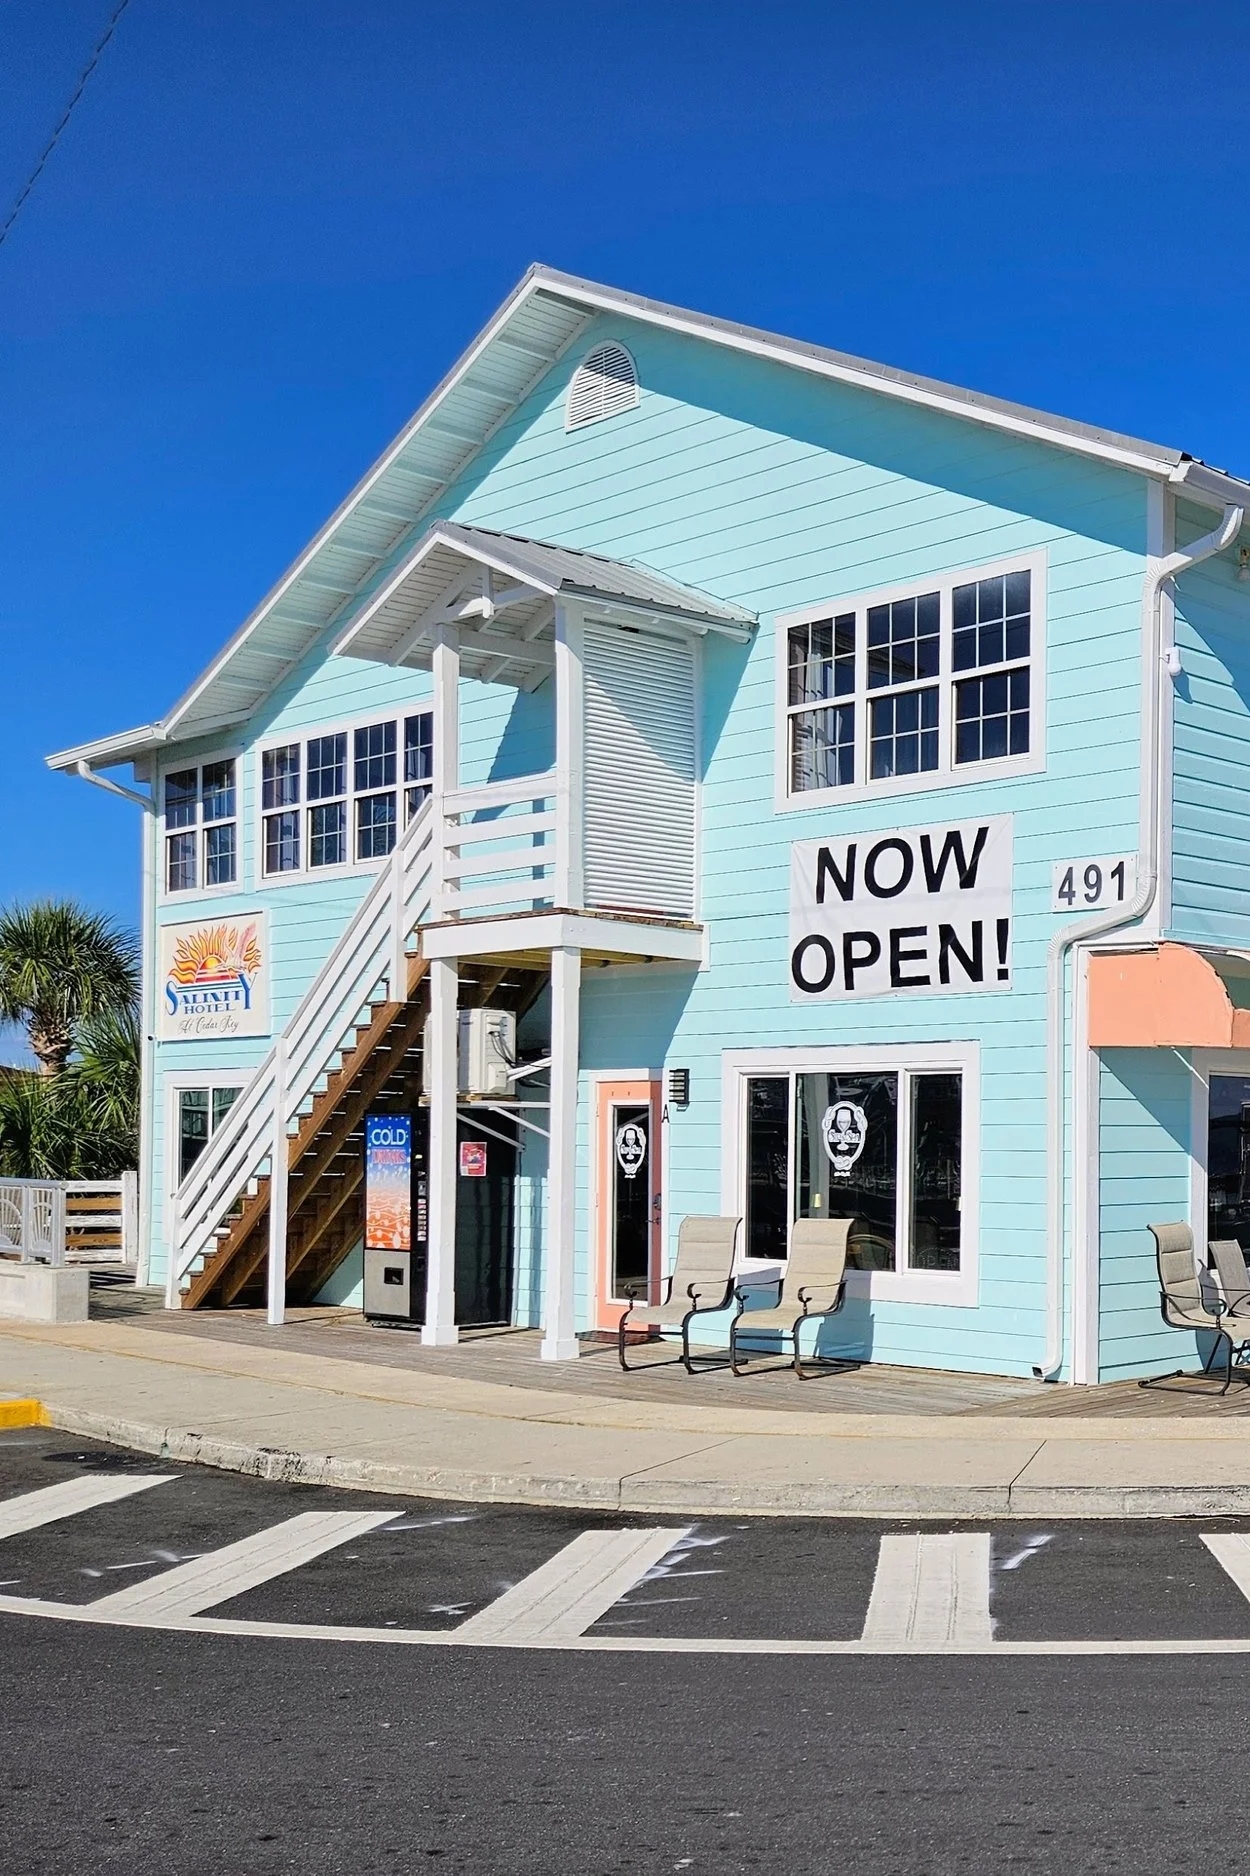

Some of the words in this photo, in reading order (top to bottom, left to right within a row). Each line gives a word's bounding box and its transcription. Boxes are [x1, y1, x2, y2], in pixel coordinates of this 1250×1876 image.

[816, 826, 989, 904] NOW
[1058, 861, 1125, 905] 491
[791, 918, 1009, 993] OPEN!
[184, 1002, 237, 1015] HOTEL
[661, 1103, 670, 1123] A
[371, 1128, 407, 1146] COLD
